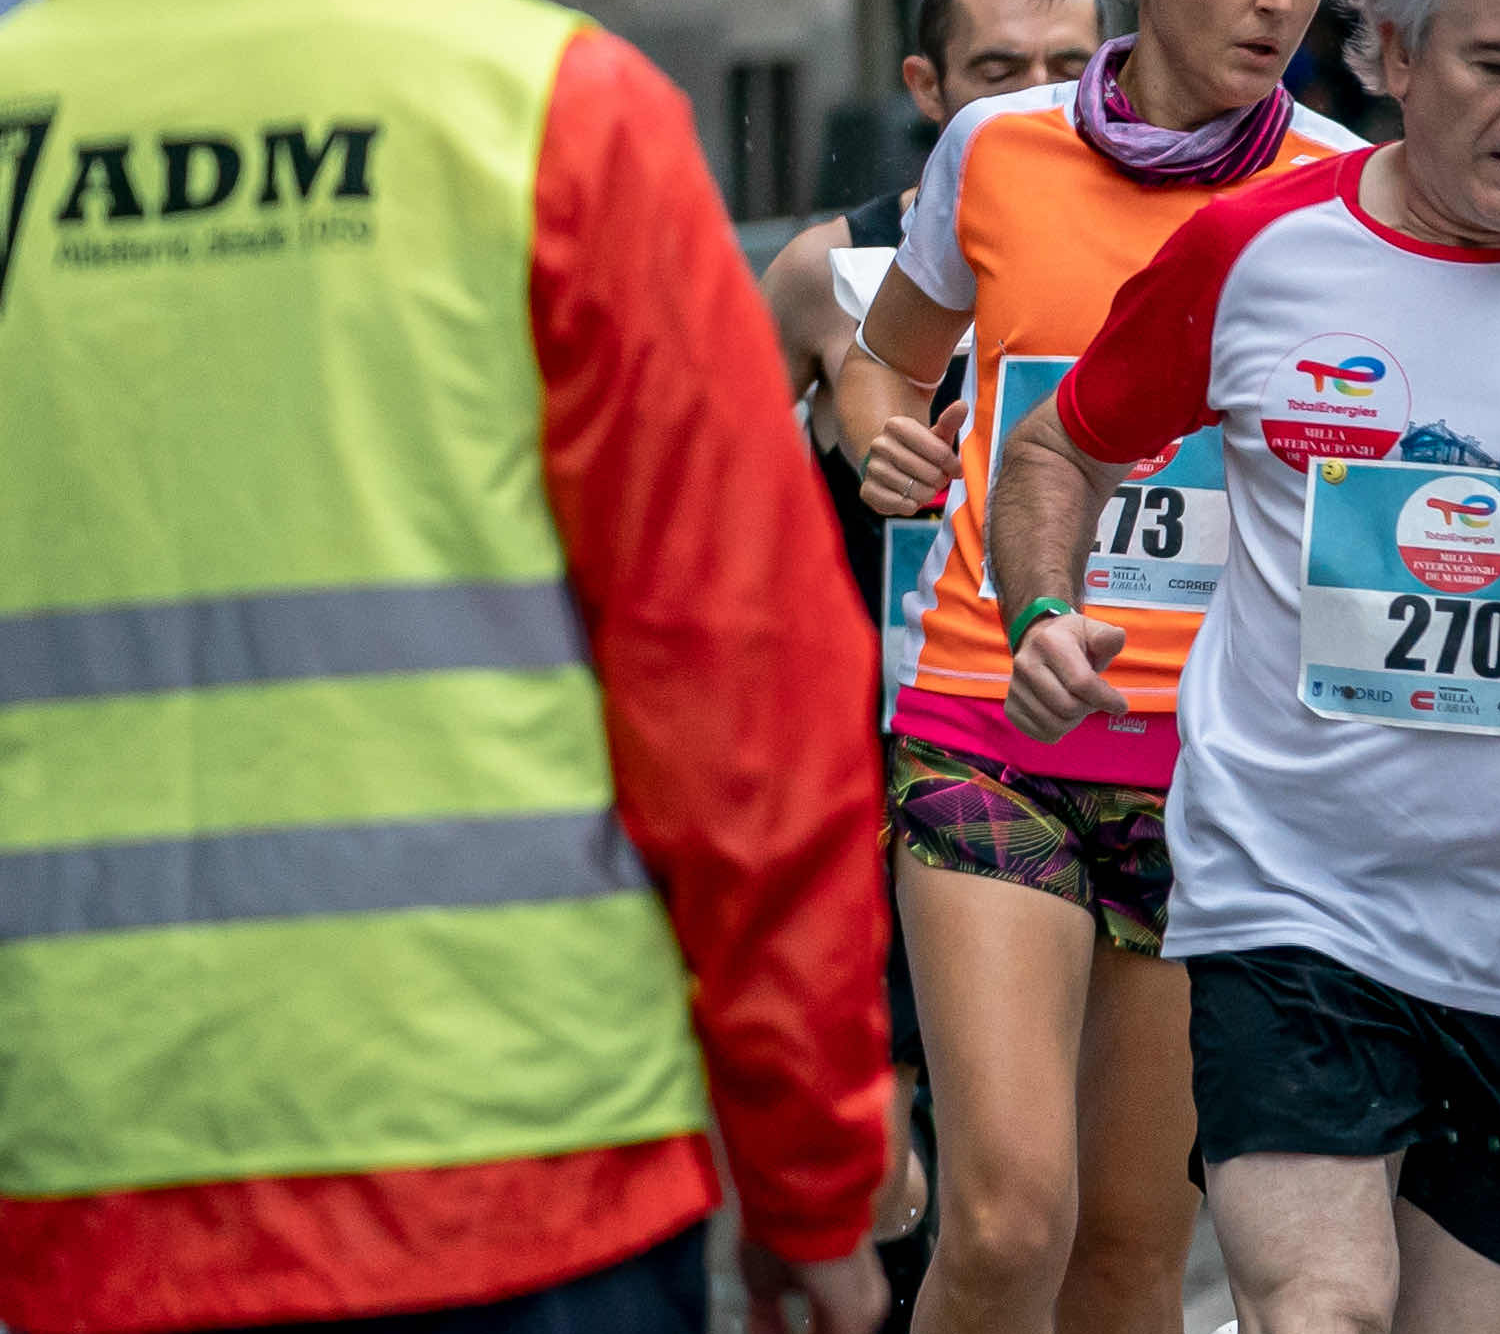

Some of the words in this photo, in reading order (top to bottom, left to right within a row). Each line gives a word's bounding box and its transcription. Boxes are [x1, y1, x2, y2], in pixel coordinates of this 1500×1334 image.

[59, 129, 378, 221] ADM
[1288, 399, 1379, 418] TotalEnergies
[1304, 427, 1346, 441] MILLA
[1271, 438, 1376, 456] INTERNACIONAL
[1091, 486, 1186, 559] 73
[1423, 530, 1495, 545] TotalEnergies
[1440, 552, 1474, 564] MILLA
[1112, 569, 1147, 582] MILLA
[1413, 560, 1499, 576] INTERNACIONAL
[1425, 572, 1441, 582] DE
[1443, 573, 1485, 585] MADRID
[1331, 684, 1393, 703] MDRID
[1438, 690, 1475, 704] MILLA
